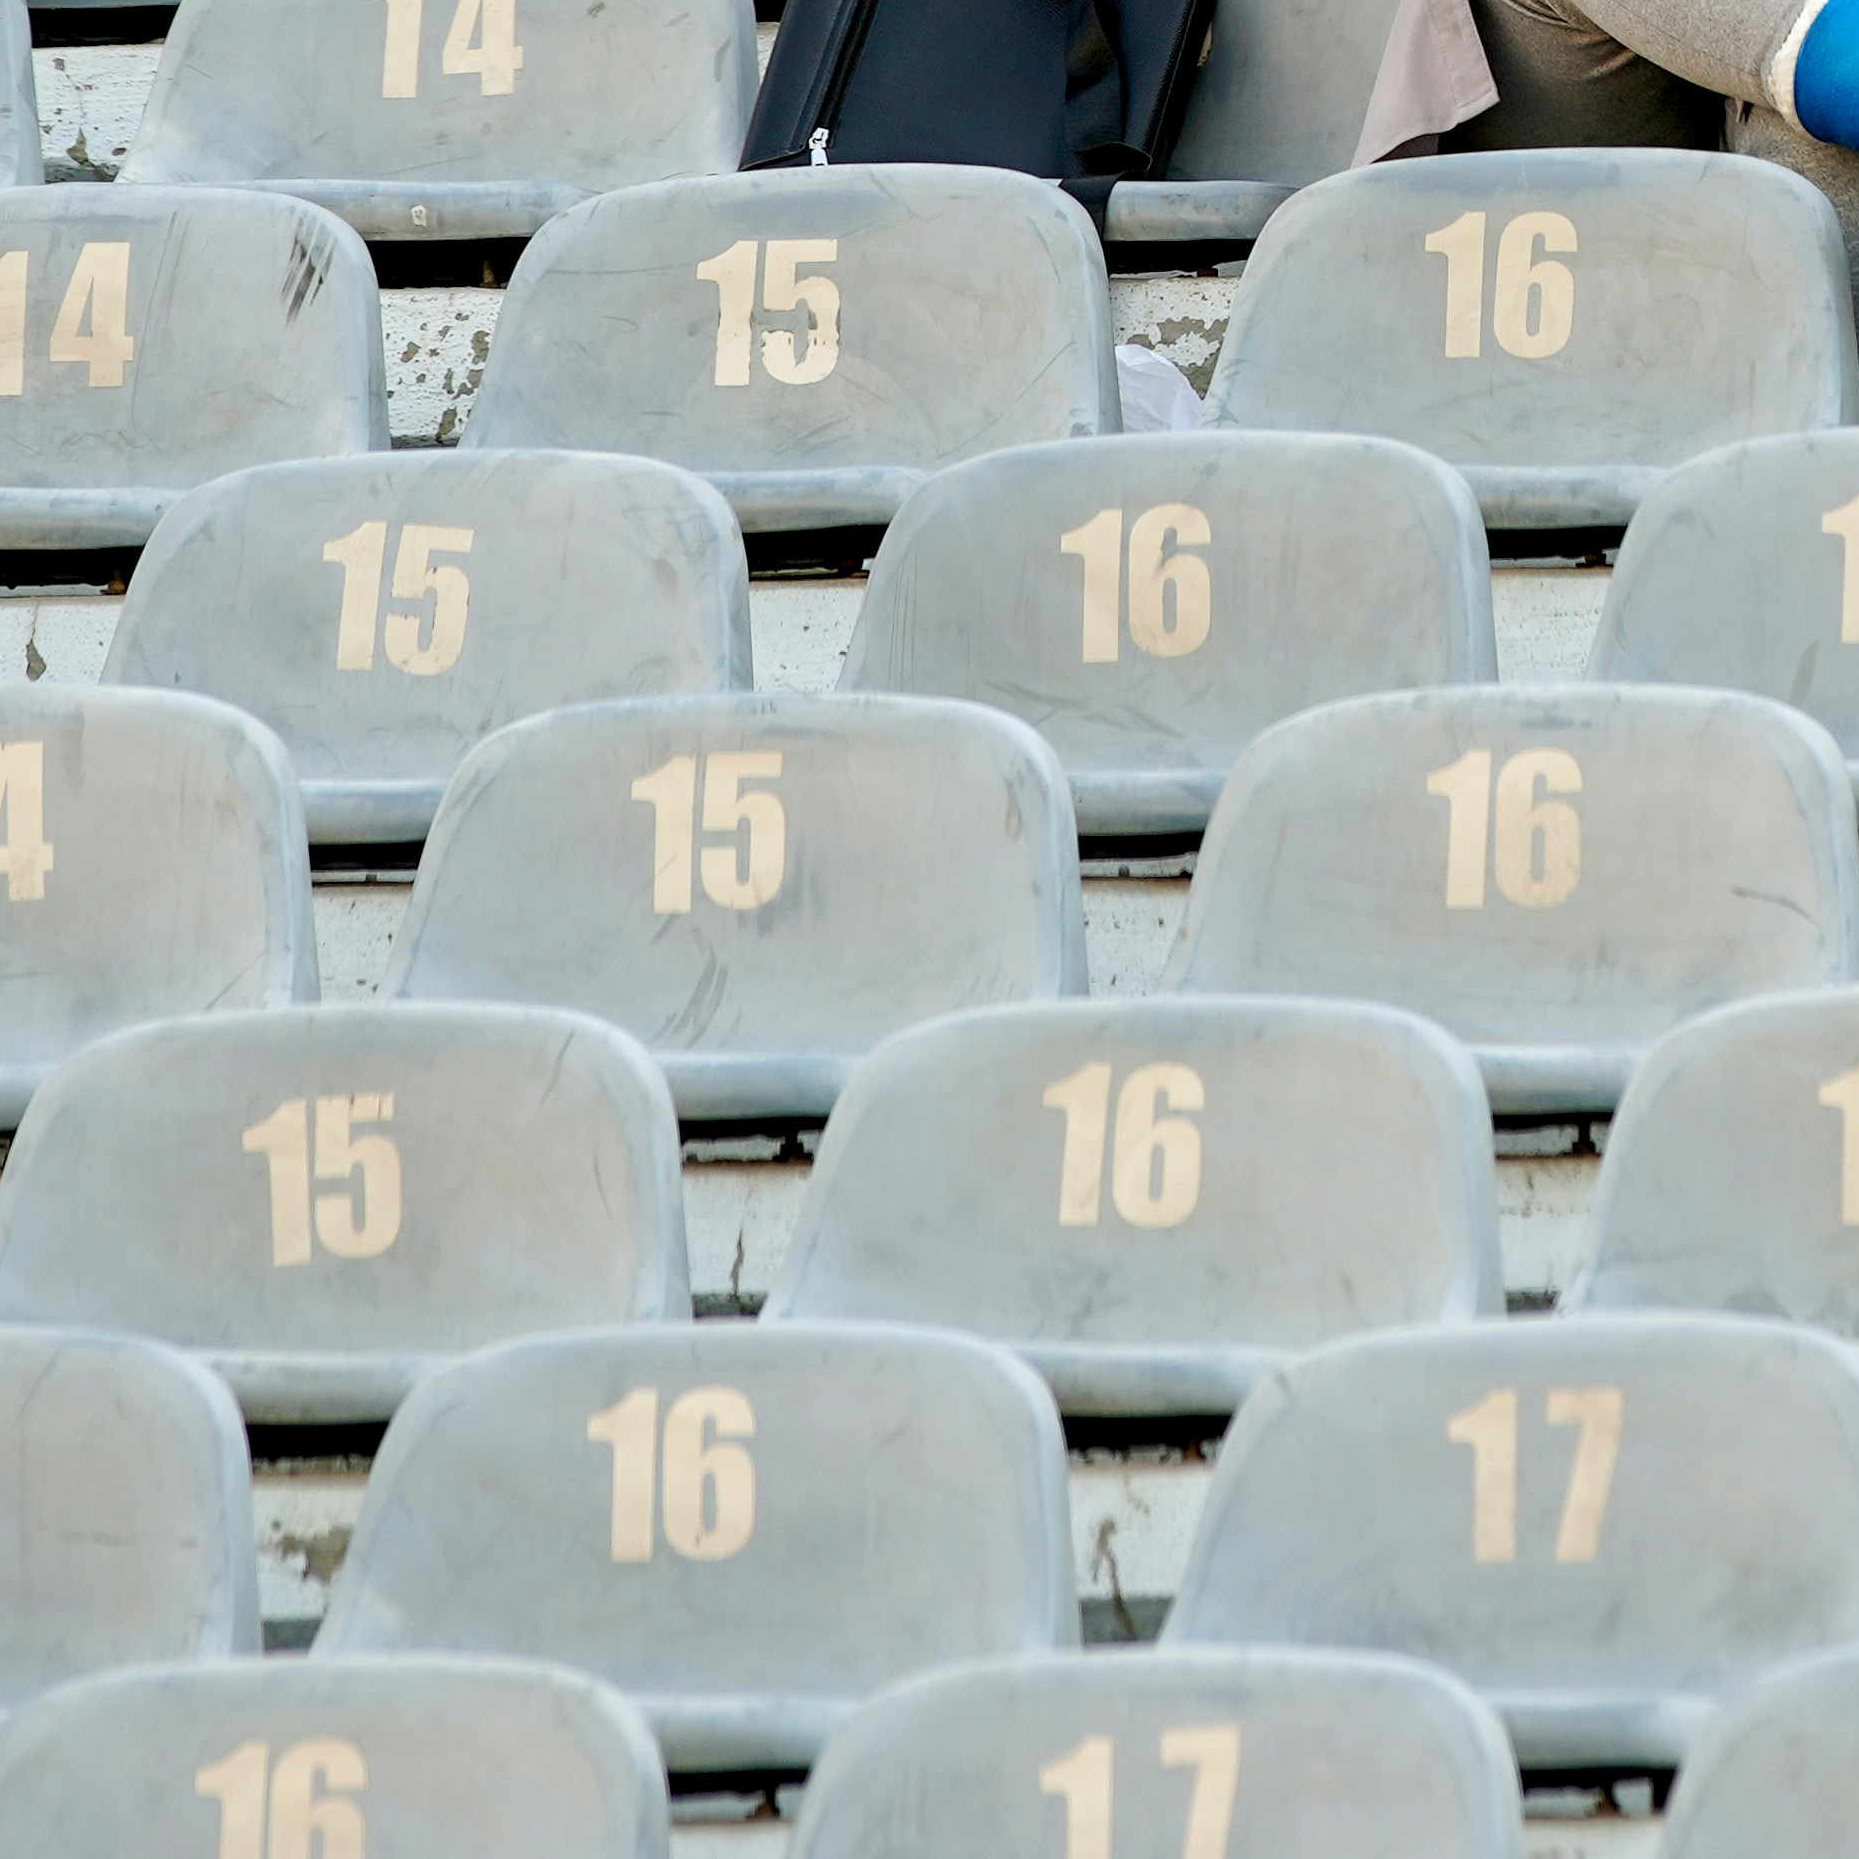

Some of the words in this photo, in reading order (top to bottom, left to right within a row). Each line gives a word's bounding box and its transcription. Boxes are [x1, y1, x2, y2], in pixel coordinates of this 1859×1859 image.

[695, 238, 843, 386] 15
[1425, 211, 1580, 358] 16
[323, 521, 473, 675] 15
[1061, 504, 1212, 663] 16
[630, 749, 786, 914] 15
[1426, 749, 1582, 908] 16
[242, 1093, 402, 1264] 15
[1042, 1062, 1204, 1227] 16
[587, 1387, 755, 1562] 16
[1448, 1388, 1625, 1562] 17
[196, 1737, 368, 1859] 16
[1040, 1724, 1241, 1859] 17
